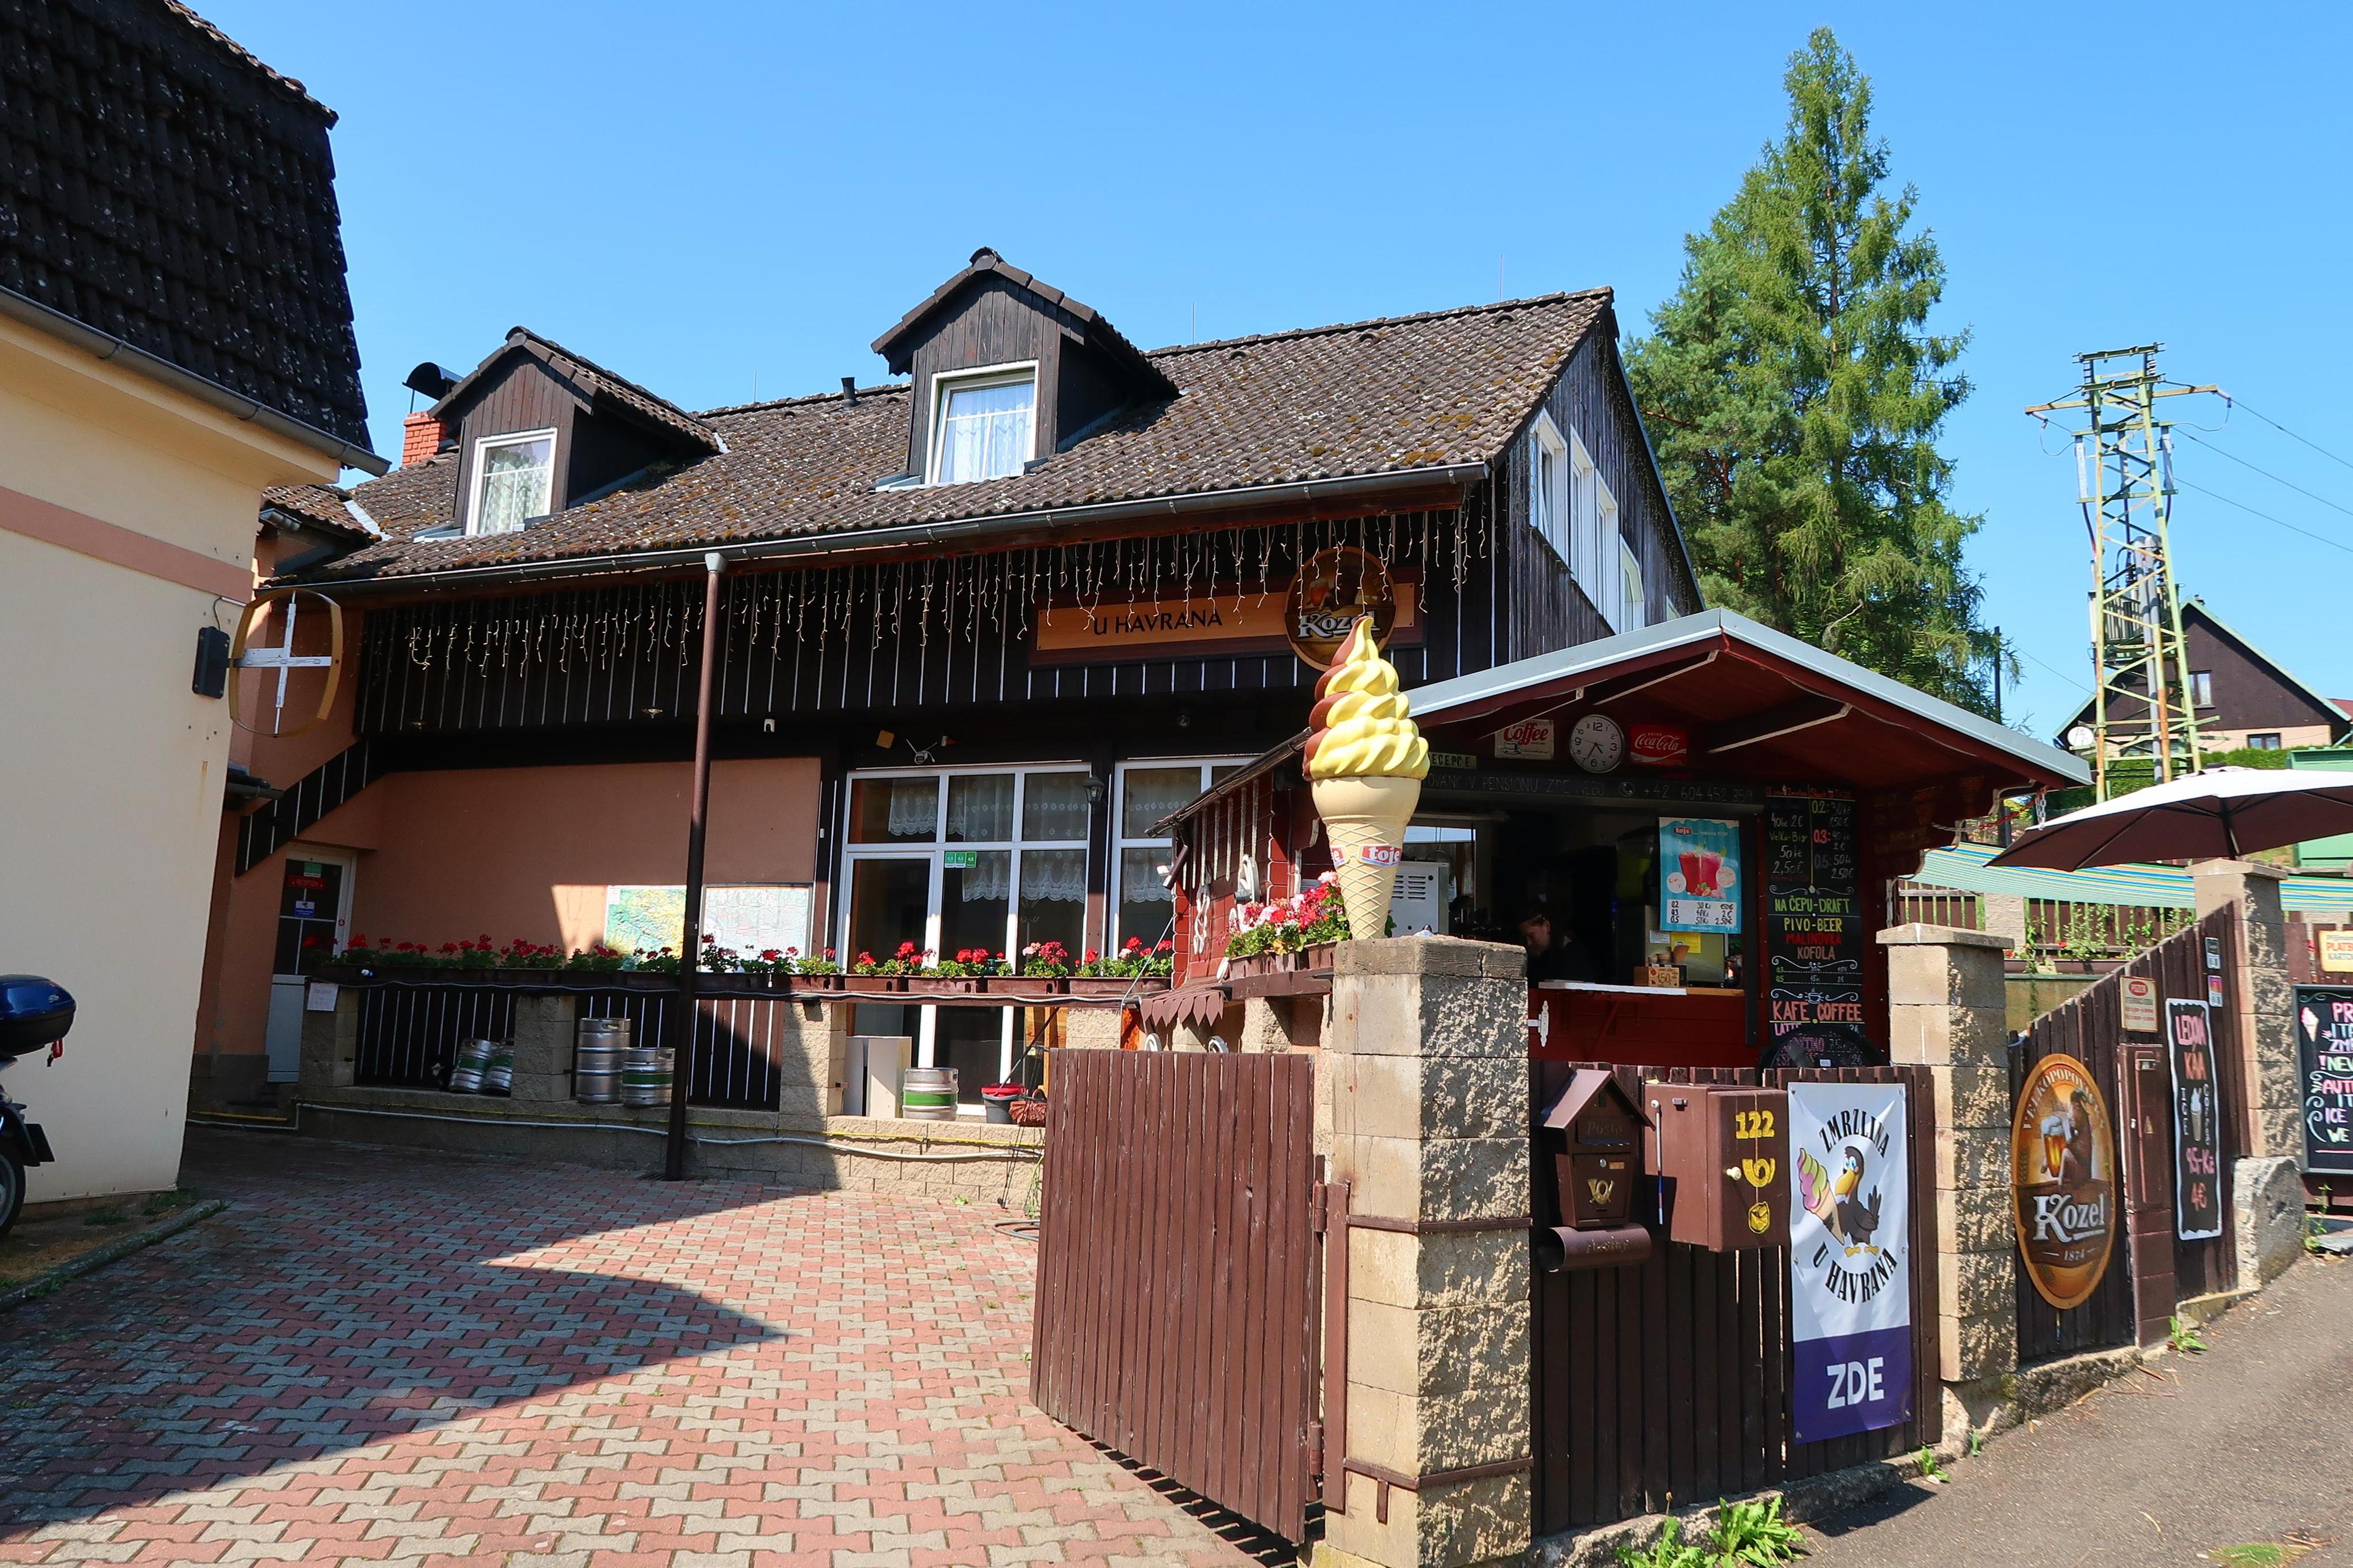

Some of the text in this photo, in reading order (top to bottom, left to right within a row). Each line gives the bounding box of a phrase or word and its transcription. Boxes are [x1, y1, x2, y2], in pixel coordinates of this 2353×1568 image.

[1094, 609, 1224, 635] U HAVRANA
[1503, 722, 1548, 745] Coffee
[1593, 722, 1602, 732] 12
[1575, 738, 1581, 746] 9
[1609, 743, 1617, 751] 3
[1432, 753, 1470, 768] ECEPCE
[1591, 759, 1597, 767] 6
[1681, 786, 1703, 800] 604
[1368, 846, 1400, 865] toje
[1774, 898, 1787, 912] NA
[1797, 946, 1835, 960] KOFOLA
[1772, 1000, 1862, 1021] KAFE COFFEE
[1774, 1022, 1802, 1036] LATT
[2328, 1039, 2353, 1052] ZM
[2324, 1107, 2349, 1125] ICE
[1735, 1109, 1775, 1139] 122
[1818, 1107, 1891, 1158] ZMRZLINA
[2032, 1193, 2105, 1243] Kozel
[2064, 1248, 2085, 1262] 1874
[1812, 1242, 1898, 1305] U HAVRANA
[1826, 1356, 1885, 1409] ZDE
